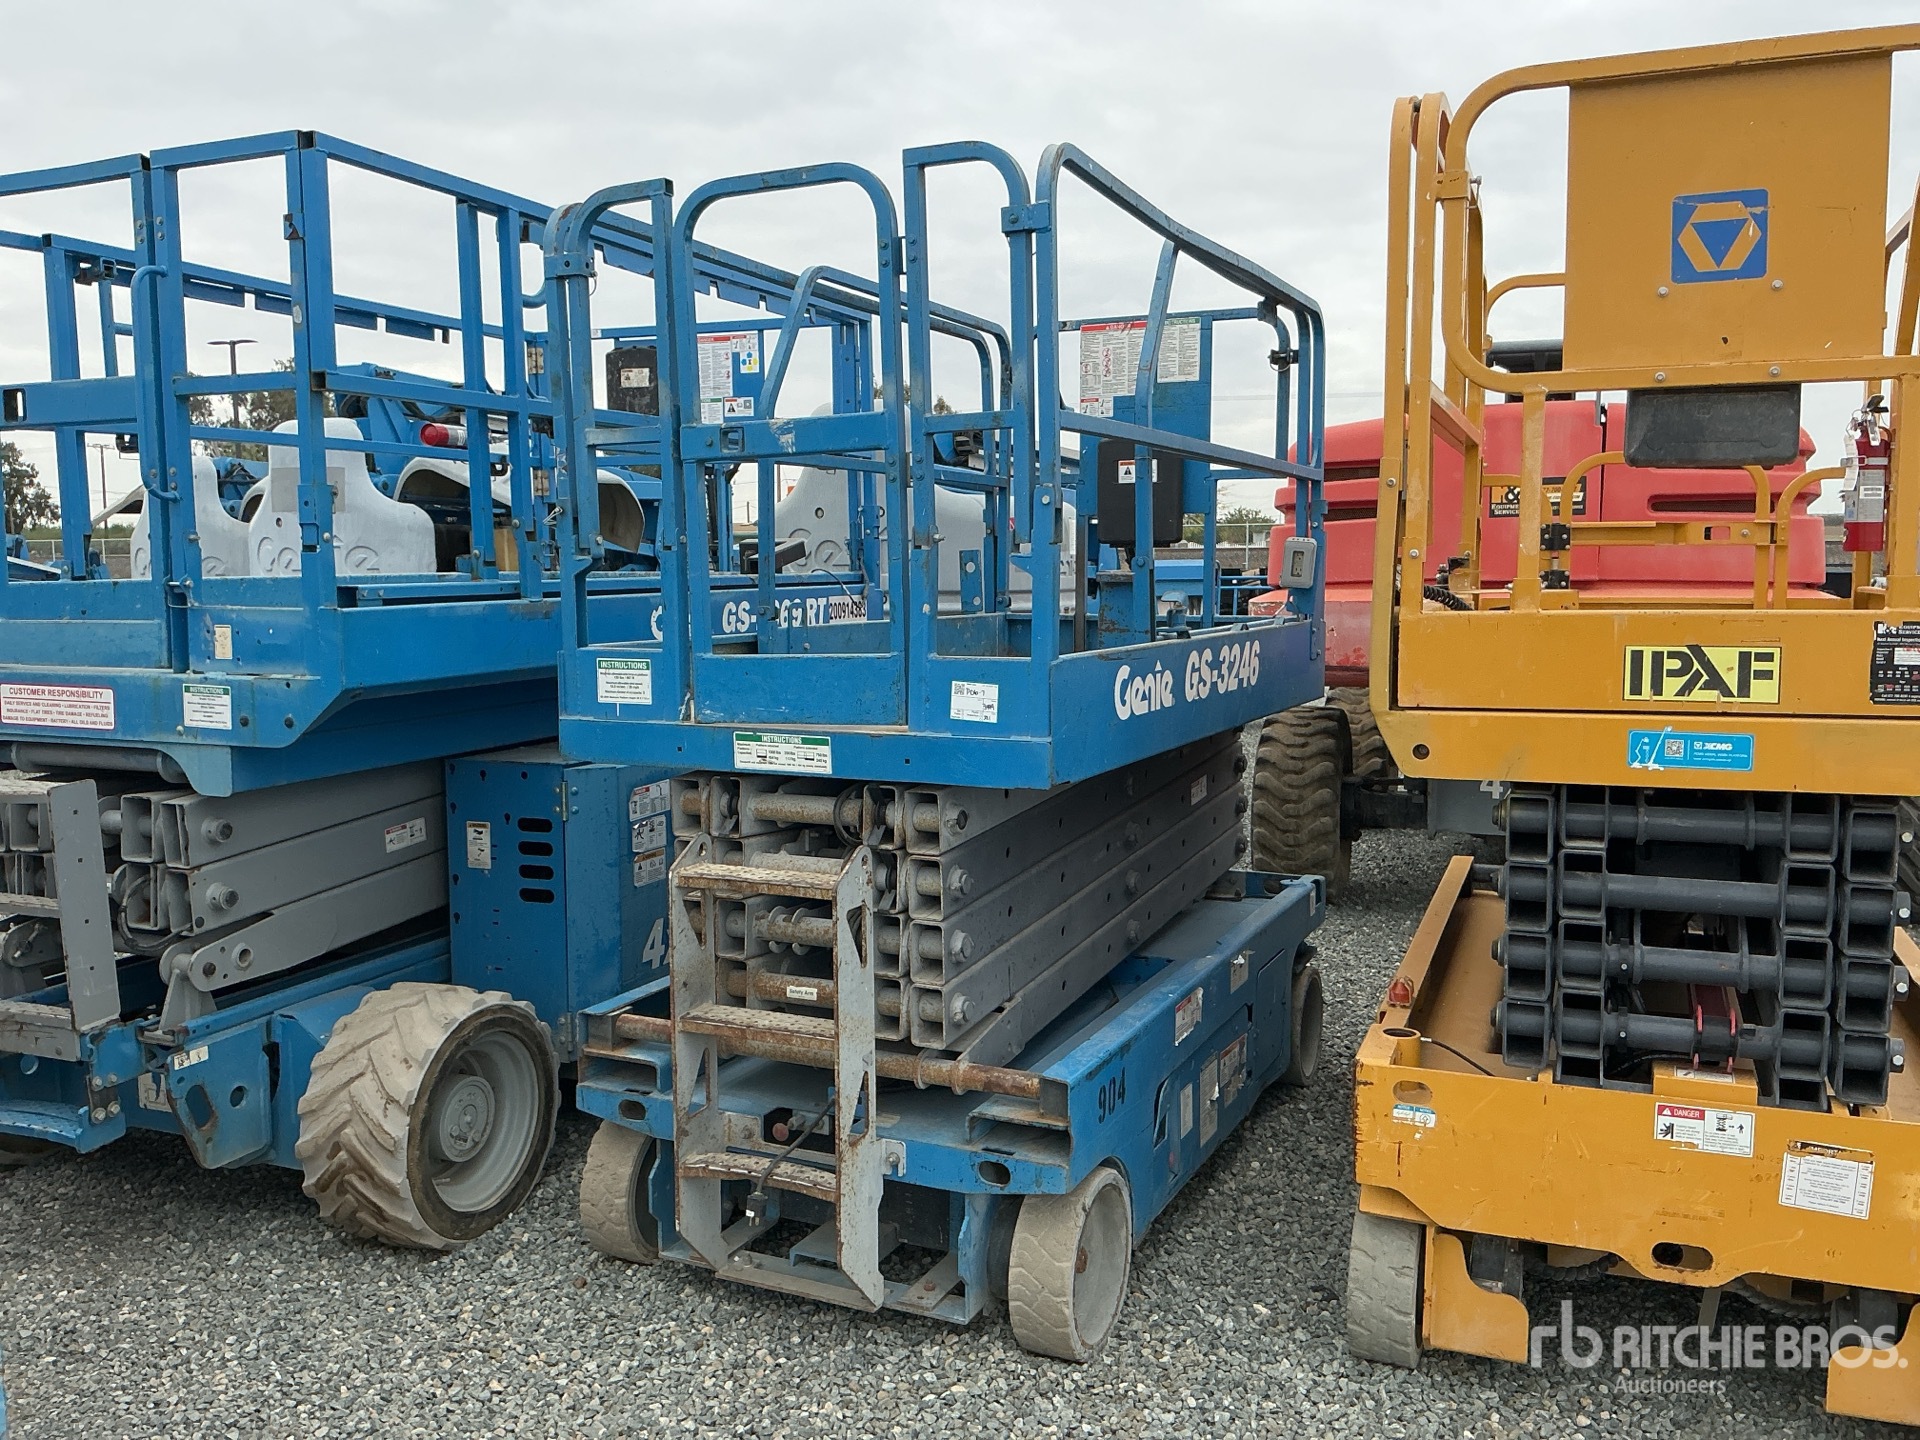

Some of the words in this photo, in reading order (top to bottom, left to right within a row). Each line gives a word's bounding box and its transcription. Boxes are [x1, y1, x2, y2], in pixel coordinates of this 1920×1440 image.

[806, 597, 828, 627] RT
[600, 660, 647, 670] INSTRUCTIONS
[1628, 644, 1775, 699] IPAF
[1114, 659, 1175, 721] Genie
[1185, 639, 1261, 703] GS-3246
[9, 687, 46, 696] CUSTOMER
[47, 689, 104, 699] RESPONSIBILITY
[761, 734, 802, 745] INSTRUCTIONS
[1097, 1066, 1126, 1125] 904
[1673, 1108, 1700, 1118] DANGER
